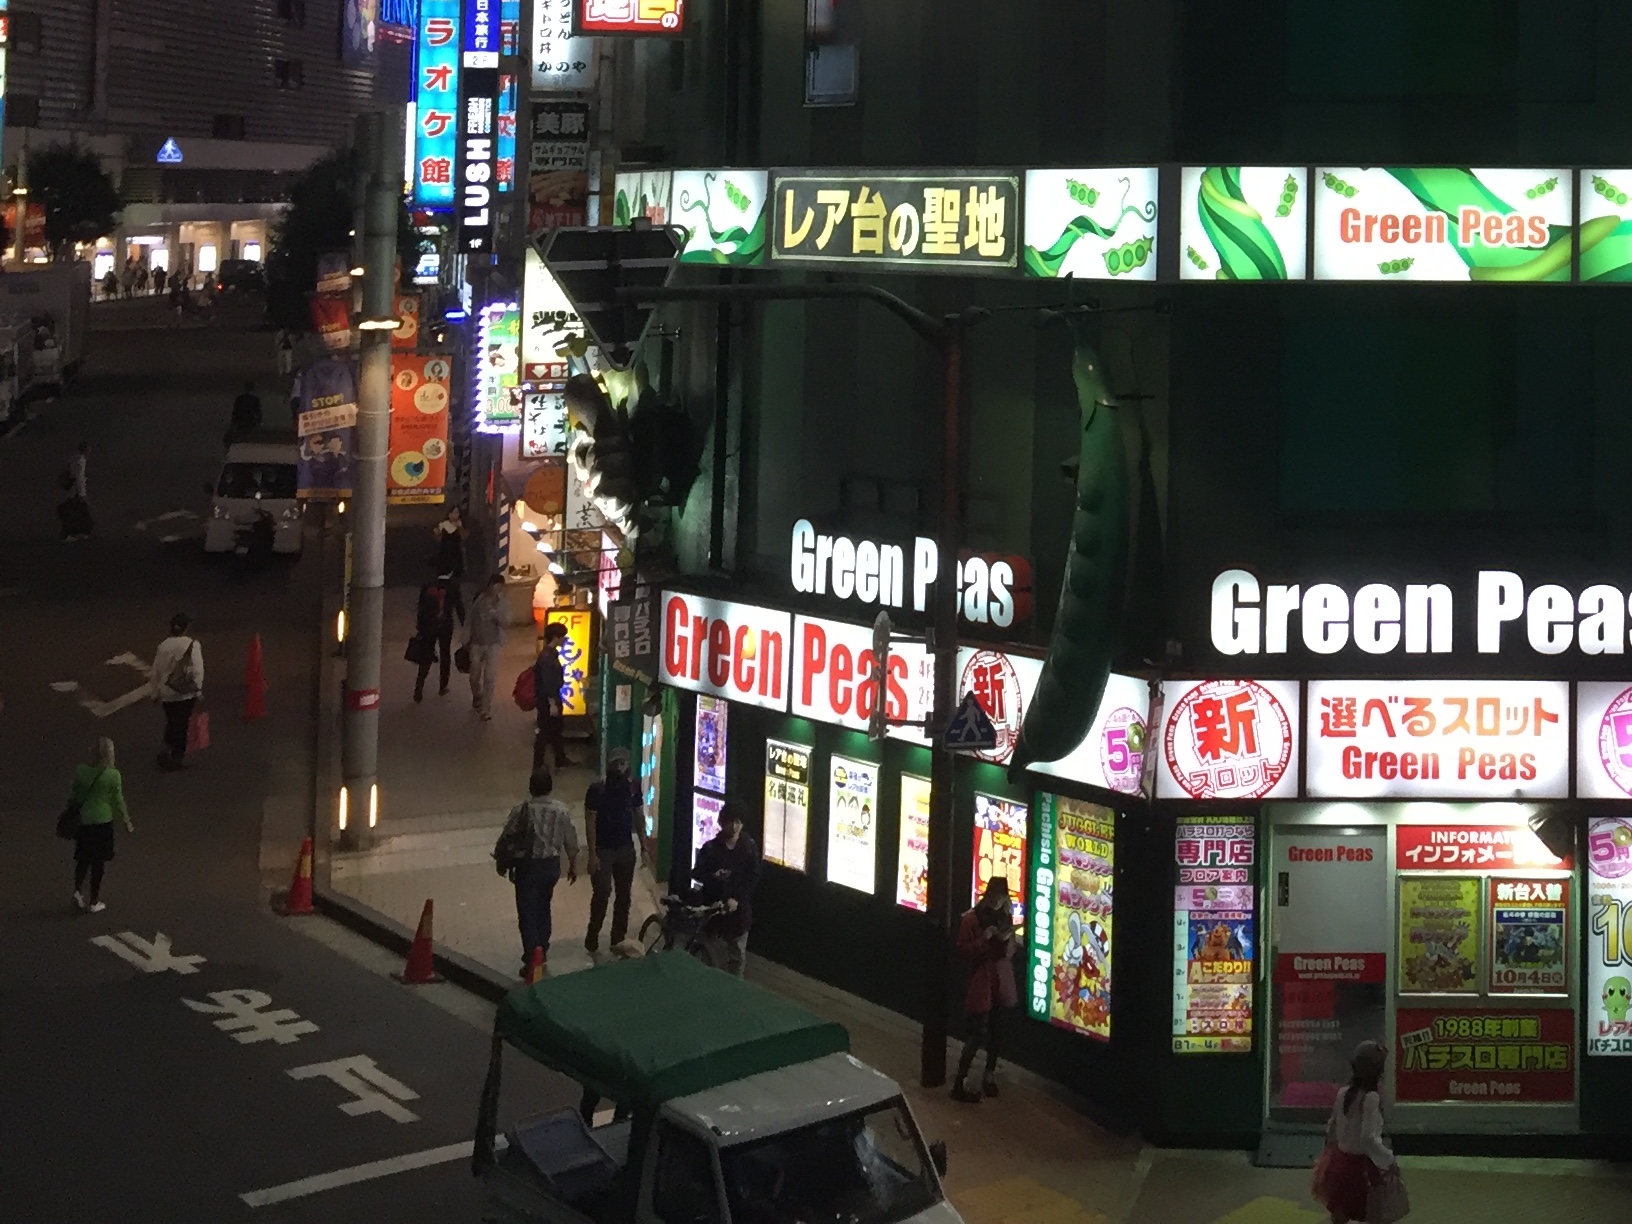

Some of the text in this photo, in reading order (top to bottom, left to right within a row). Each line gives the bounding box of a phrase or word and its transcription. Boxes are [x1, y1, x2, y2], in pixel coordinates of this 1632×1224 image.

[464, 138, 492, 227] LUSH
[783, 185, 1006, 257] レア台の聖地
[1339, 207, 1548, 248] Green Peas
[790, 518, 1015, 628] Green Pas
[1210, 568, 1454, 656] Green
[663, 595, 910, 722] Green Peas
[1189, 687, 1261, 765] 新
[1319, 694, 1560, 740] 選べるスロット
[1188, 757, 1282, 795] スロット
[1341, 745, 1537, 781] Green Peas
[1064, 833, 1110, 857] WORLD
[1175, 838, 1255, 866] 専門店
[1288, 845, 1374, 862] Green Peas
[1180, 868, 1248, 883] フロア案内
[1497, 882, 1563, 901] 新台入替
[1031, 791, 1055, 1015] Pachislo Green Peas
[1403, 1042, 1570, 1072] パチスロ専門店
